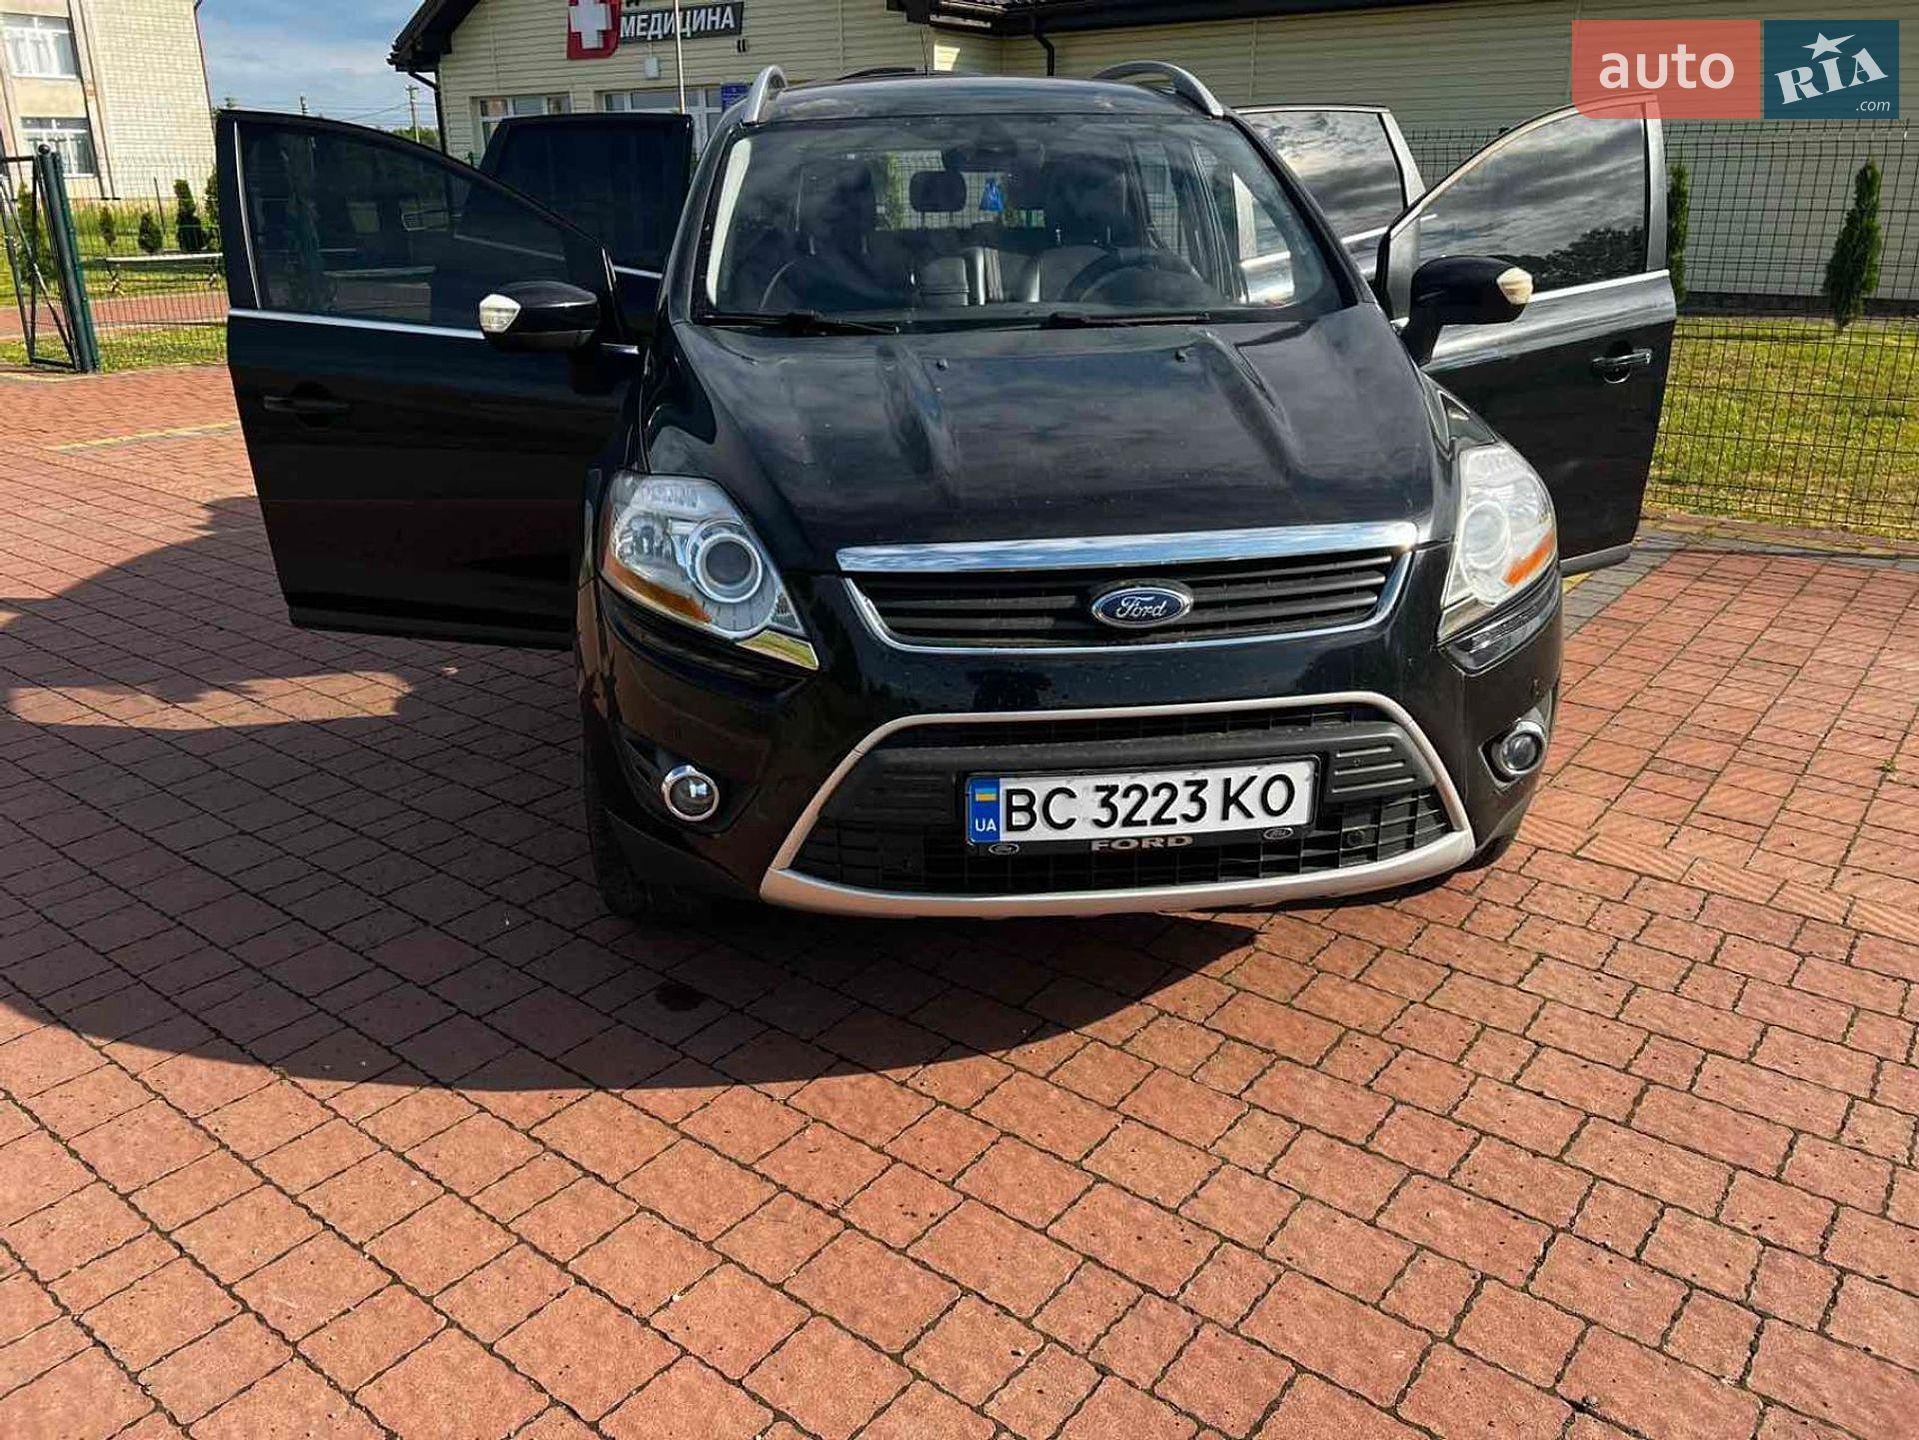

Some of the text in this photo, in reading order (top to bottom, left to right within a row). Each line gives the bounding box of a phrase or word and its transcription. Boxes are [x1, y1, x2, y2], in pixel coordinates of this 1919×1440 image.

[620, 6, 735, 40] МЕДИЦИНА
[1116, 595, 1167, 618] Ford
[1006, 787, 1077, 832] BC
[1092, 779, 1207, 828] 3223
[975, 818, 997, 832] UA
[1091, 835, 1193, 851] FORD
